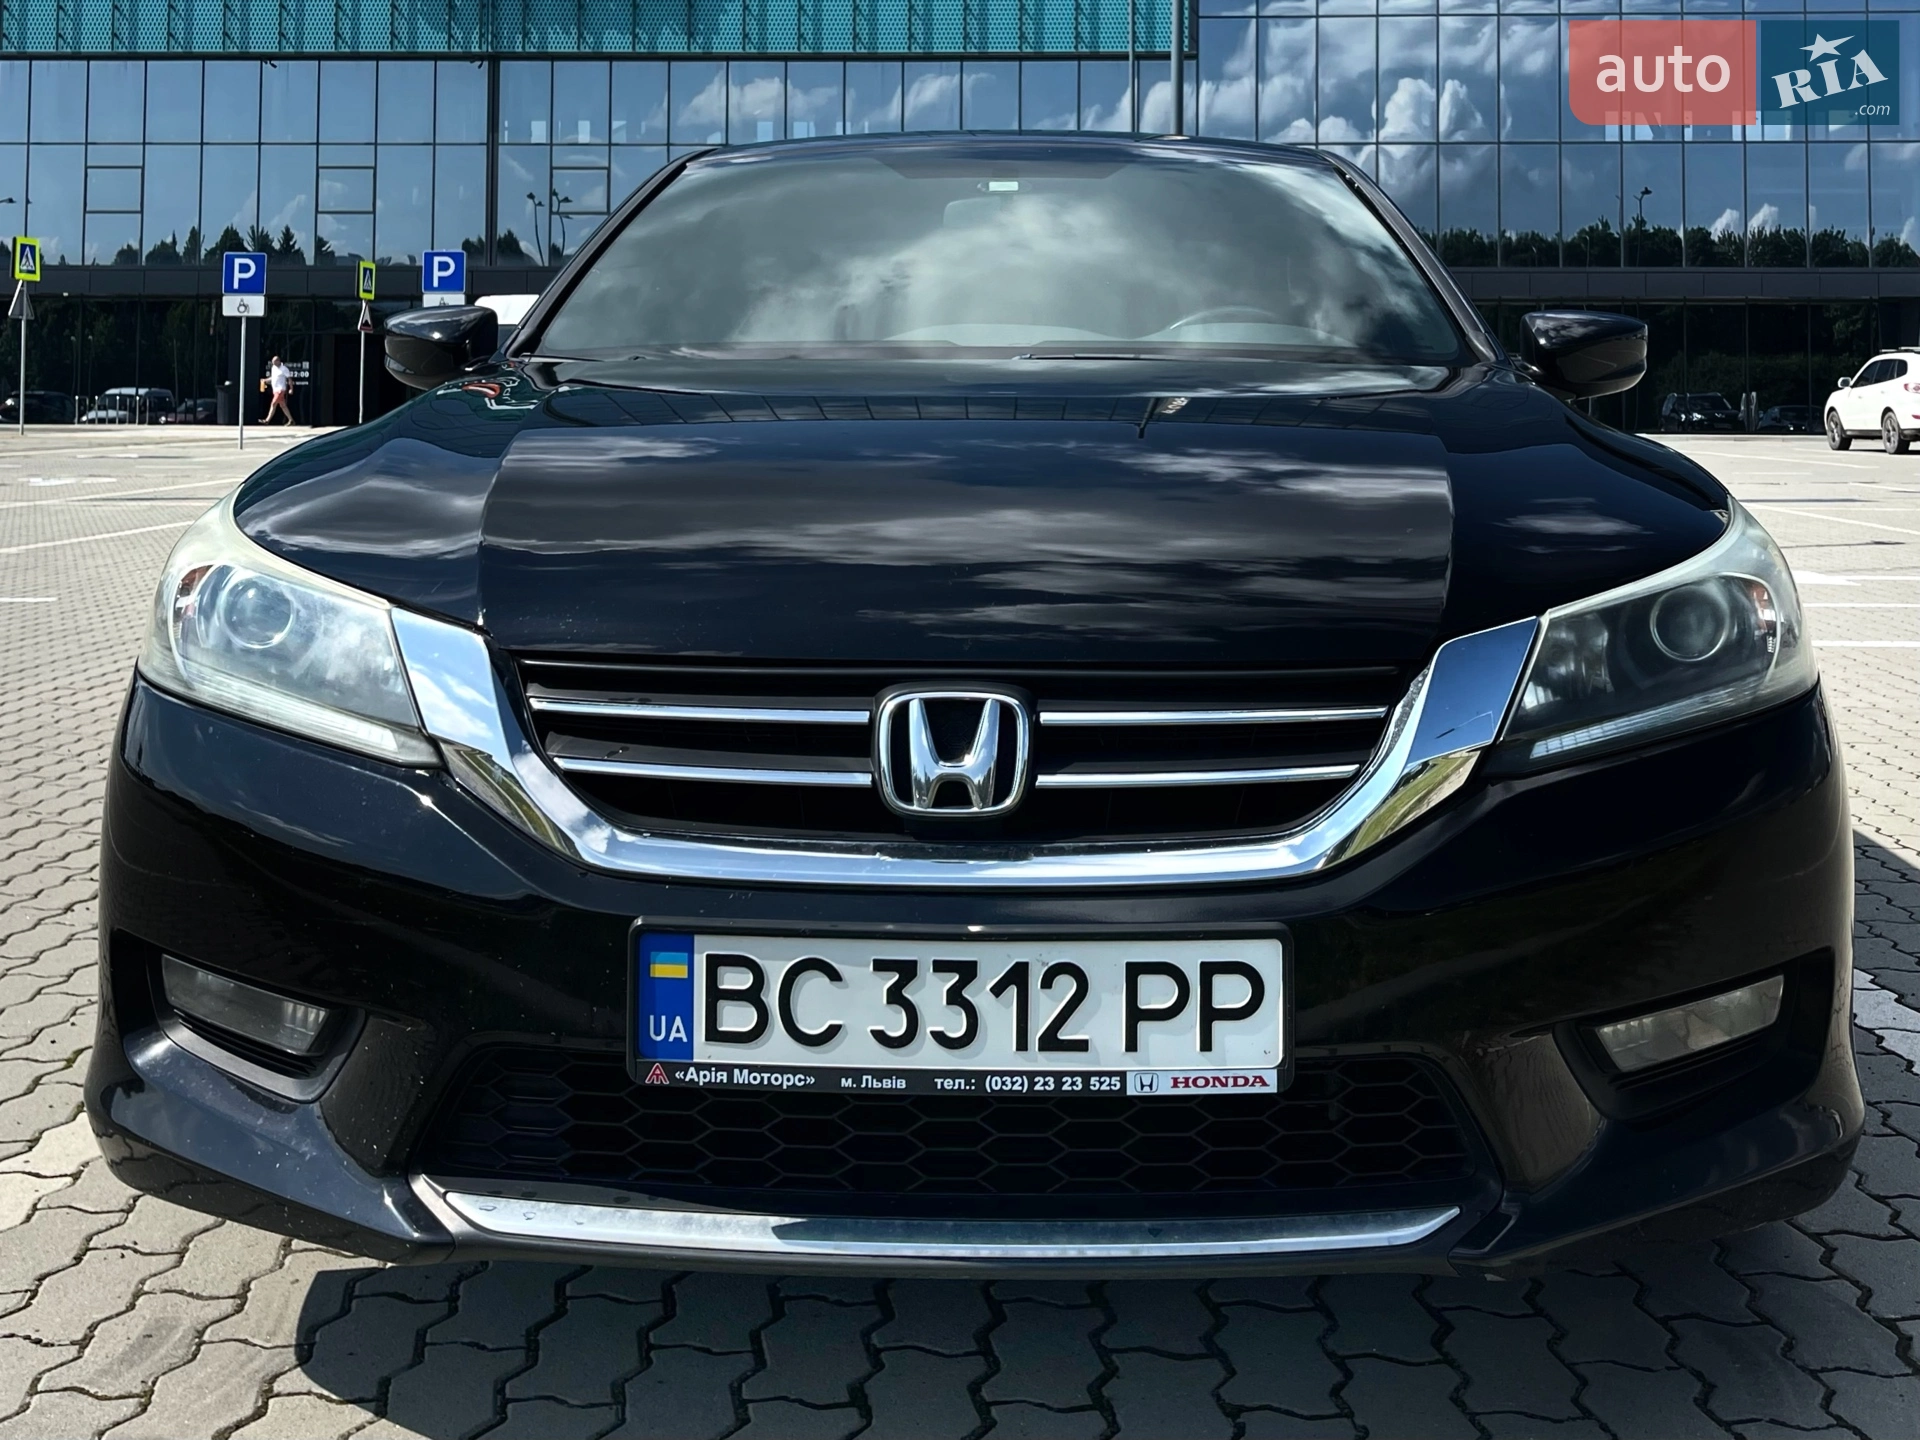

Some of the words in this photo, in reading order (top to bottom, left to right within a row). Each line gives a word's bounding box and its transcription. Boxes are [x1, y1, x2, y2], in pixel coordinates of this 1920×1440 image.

[233, 258, 256, 289] P
[433, 256, 455, 287] P
[703, 953, 844, 1050] BC
[868, 958, 1091, 1053] 3312
[1123, 960, 1266, 1053] PP
[649, 1015, 688, 1042] UA
[675, 1067, 727, 1085] «Арія
[733, 1069, 815, 1089] Моторс»
[841, 1078, 856, 1088] м.
[861, 1075, 906, 1089] Львів
[935, 1078, 976, 1090] тел.:
[985, 1076, 1028, 1093] (032)
[1034, 1077, 1055, 1091] 23
[1062, 1077, 1082, 1091] 23
[1089, 1076, 1121, 1091] 525
[1171, 1075, 1270, 1089] HONDA
